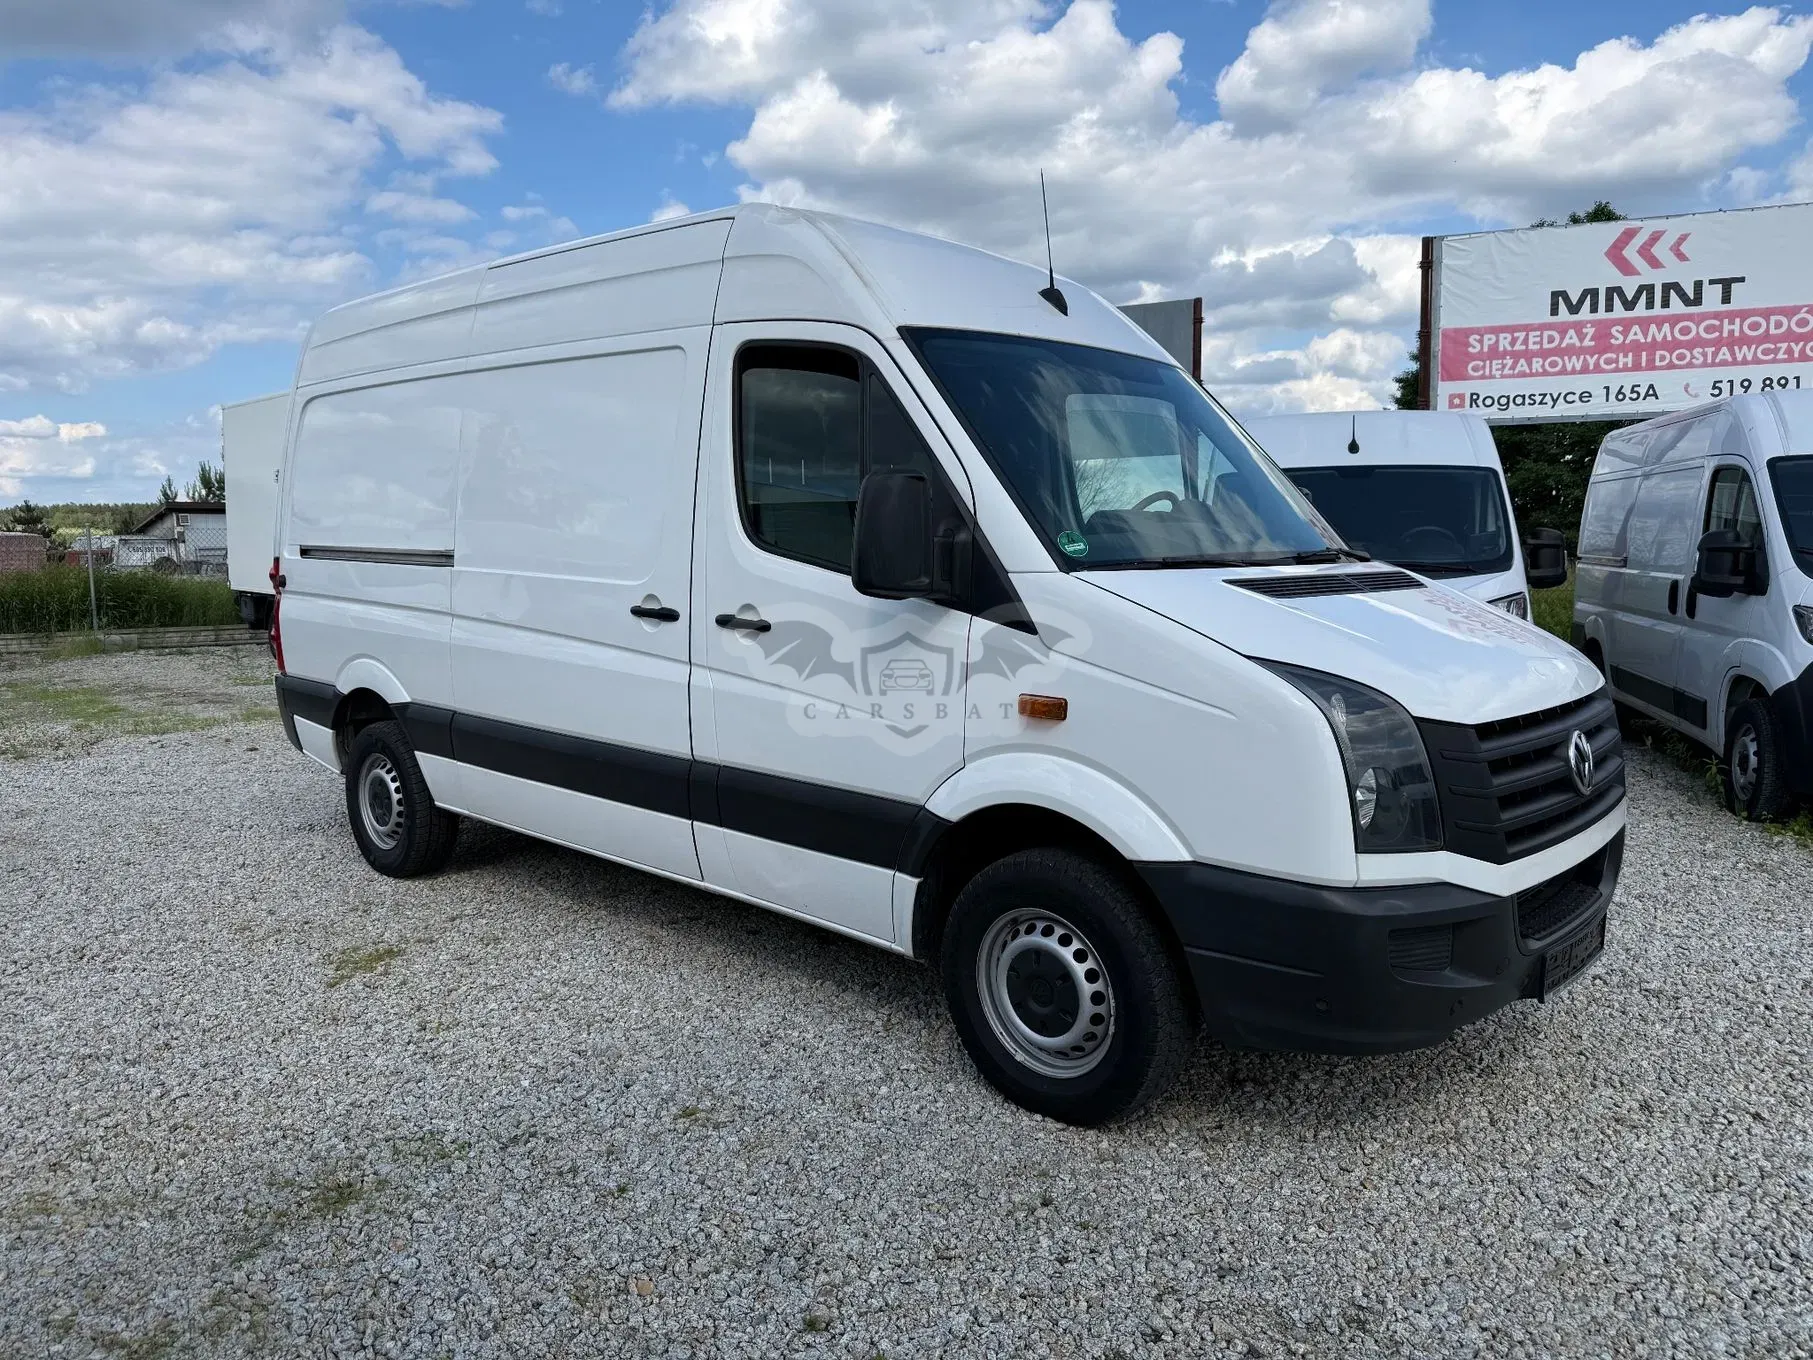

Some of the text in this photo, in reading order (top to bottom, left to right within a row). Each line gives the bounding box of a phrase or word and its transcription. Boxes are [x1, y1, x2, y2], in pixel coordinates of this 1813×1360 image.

[1549, 276, 1746, 316] MMNT
[1467, 324, 1596, 353] SPRZEDAŻ
[1467, 351, 1633, 378] CIĘŻAROWYCH
[1641, 351, 1647, 368] I
[1469, 383, 1660, 411] Rogaszyce 165A
[1709, 375, 1801, 398] 519 891
